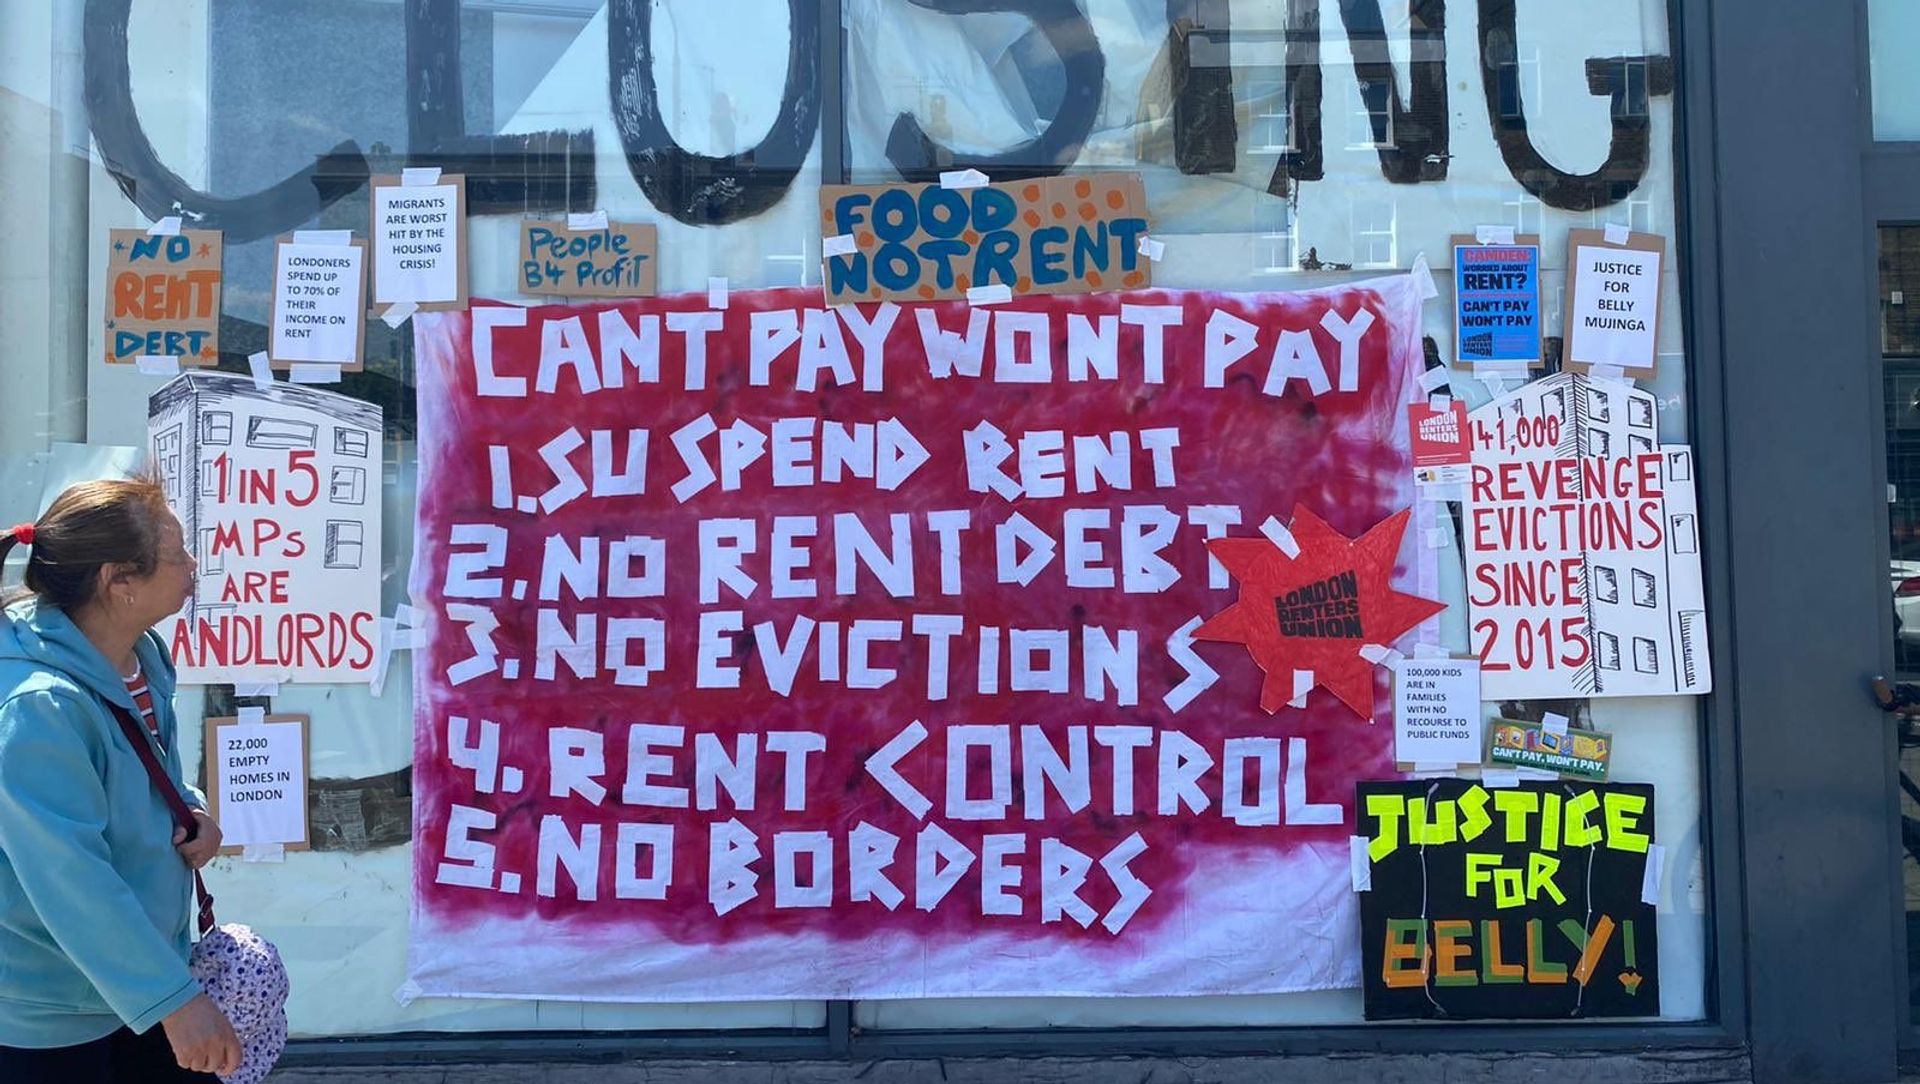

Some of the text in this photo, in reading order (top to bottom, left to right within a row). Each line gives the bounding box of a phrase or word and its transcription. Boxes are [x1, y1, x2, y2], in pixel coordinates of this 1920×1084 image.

[388, 198, 445, 209] MIGRANTS
[386, 213, 447, 224] ARE WORST
[835, 185, 1017, 243] FOOD
[389, 228, 445, 239] HIT BY THE
[129, 235, 190, 263] NO
[393, 244, 442, 254] HOUSING
[528, 227, 631, 260] People
[288, 257, 351, 268] LONDONERS
[399, 258, 435, 269] CRISIS!
[830, 218, 1148, 296] NOT RENT
[287, 271, 338, 281] SPEND UP
[524, 260, 565, 288] B4
[1593, 262, 1642, 275] JUSTICE
[1463, 273, 1527, 290] RENT?
[1604, 281, 1629, 293] FOR
[114, 270, 221, 320] RENT
[287, 286, 341, 296] TO 70% OF
[287, 300, 316, 309] THEIR
[1463, 301, 1530, 312] CAN'T PAY
[1598, 299, 1634, 312] BELLY
[285, 315, 345, 324] INCOME ON
[1462, 315, 1532, 326] WON'T PAY
[1585, 316, 1645, 331] MUJINGA
[285, 329, 312, 338] RENT
[115, 331, 212, 358] DEBT
[471, 302, 1375, 397] CANT PAY WONT PAY
[1419, 410, 1457, 427] LONDON
[1421, 432, 1459, 444] UNION
[1468, 415, 1560, 455] 141,000
[963, 419, 1180, 503] RENT
[213, 450, 319, 507] 1 IN 5
[1472, 454, 1663, 502] REVENGE
[1473, 501, 1663, 551] EVICTIONS
[212, 519, 306, 557] MPs
[700, 513, 970, 604] RENT
[996, 504, 1242, 594] DEBT
[221, 571, 289, 603] ARE
[1275, 570, 1357, 608] LONDON
[1470, 559, 1584, 607] SINCE
[1278, 600, 1359, 622] RENTERS
[1281, 615, 1364, 639] UNION
[171, 612, 374, 669] ANDLORDS
[1474, 617, 1590, 671] 2015
[696, 610, 1221, 714] EVICTIONS
[1407, 668, 1462, 677] 100,000 KIDS
[1406, 681, 1435, 689] ARE IN
[1406, 693, 1447, 701] FAMILIES
[1406, 706, 1447, 714] WITH NO
[1407, 718, 1467, 726] RECOURSE TO
[1407, 731, 1470, 739] PUBLIC FUNDS
[228, 738, 268, 751] 22,000
[229, 755, 270, 767] EMPTY
[1492, 746, 1521, 759] CAN'T
[1521, 750, 1545, 762] PAY.
[1546, 754, 1580, 767] WON'T
[1580, 759, 1605, 772] PAY.
[230, 771, 290, 785] HOMES IN
[549, 724, 826, 811] RENT
[865, 719, 1344, 826] CONTROL
[230, 789, 282, 802] LONDON
[1366, 784, 1650, 863] JUSTICE
[708, 817, 1153, 936] BORDERS
[1466, 852, 1567, 910] FOR
[1382, 914, 1643, 996] BELLY!
